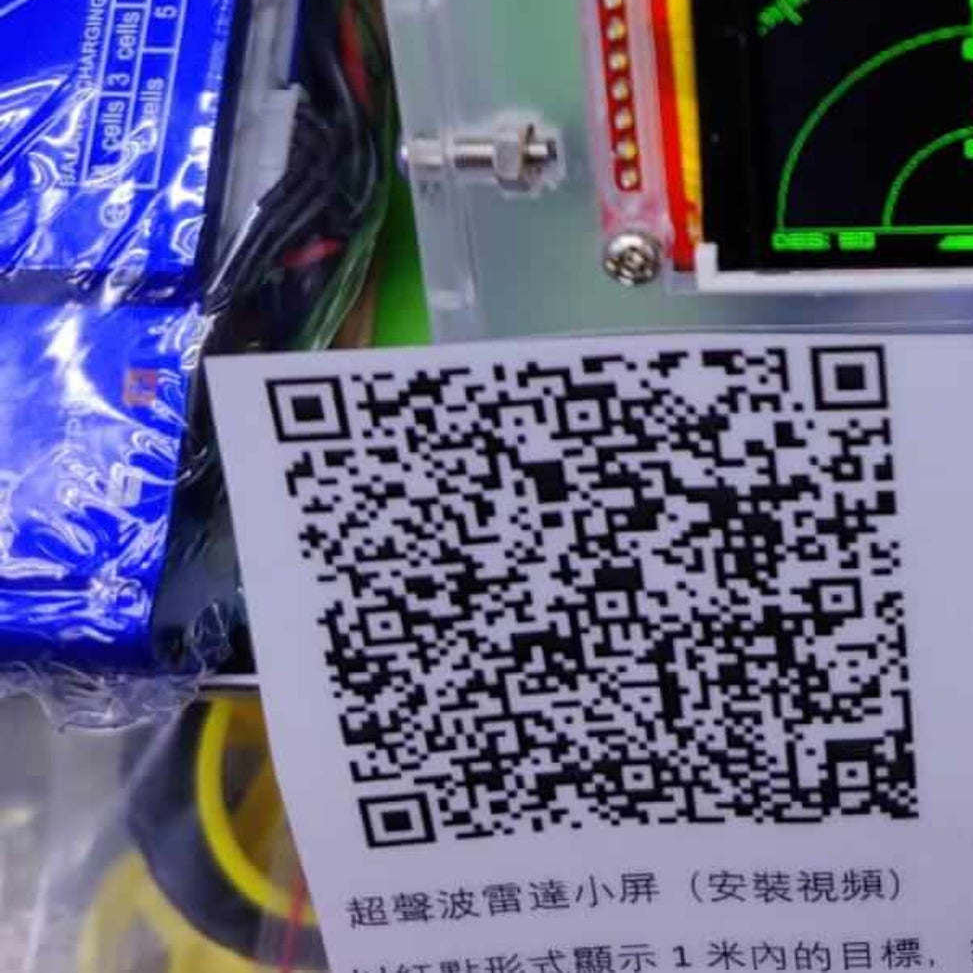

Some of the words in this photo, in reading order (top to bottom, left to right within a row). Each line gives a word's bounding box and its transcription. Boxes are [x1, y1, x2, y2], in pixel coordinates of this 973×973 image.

[154, 4, 177, 20] 5
[117, 11, 140, 61] cells
[109, 72, 130, 87] 3
[348, 869, 660, 928] 超聲波雷達小屏
[352, 944, 656, 973] 形式顯示
[672, 945, 692, 968] 1
